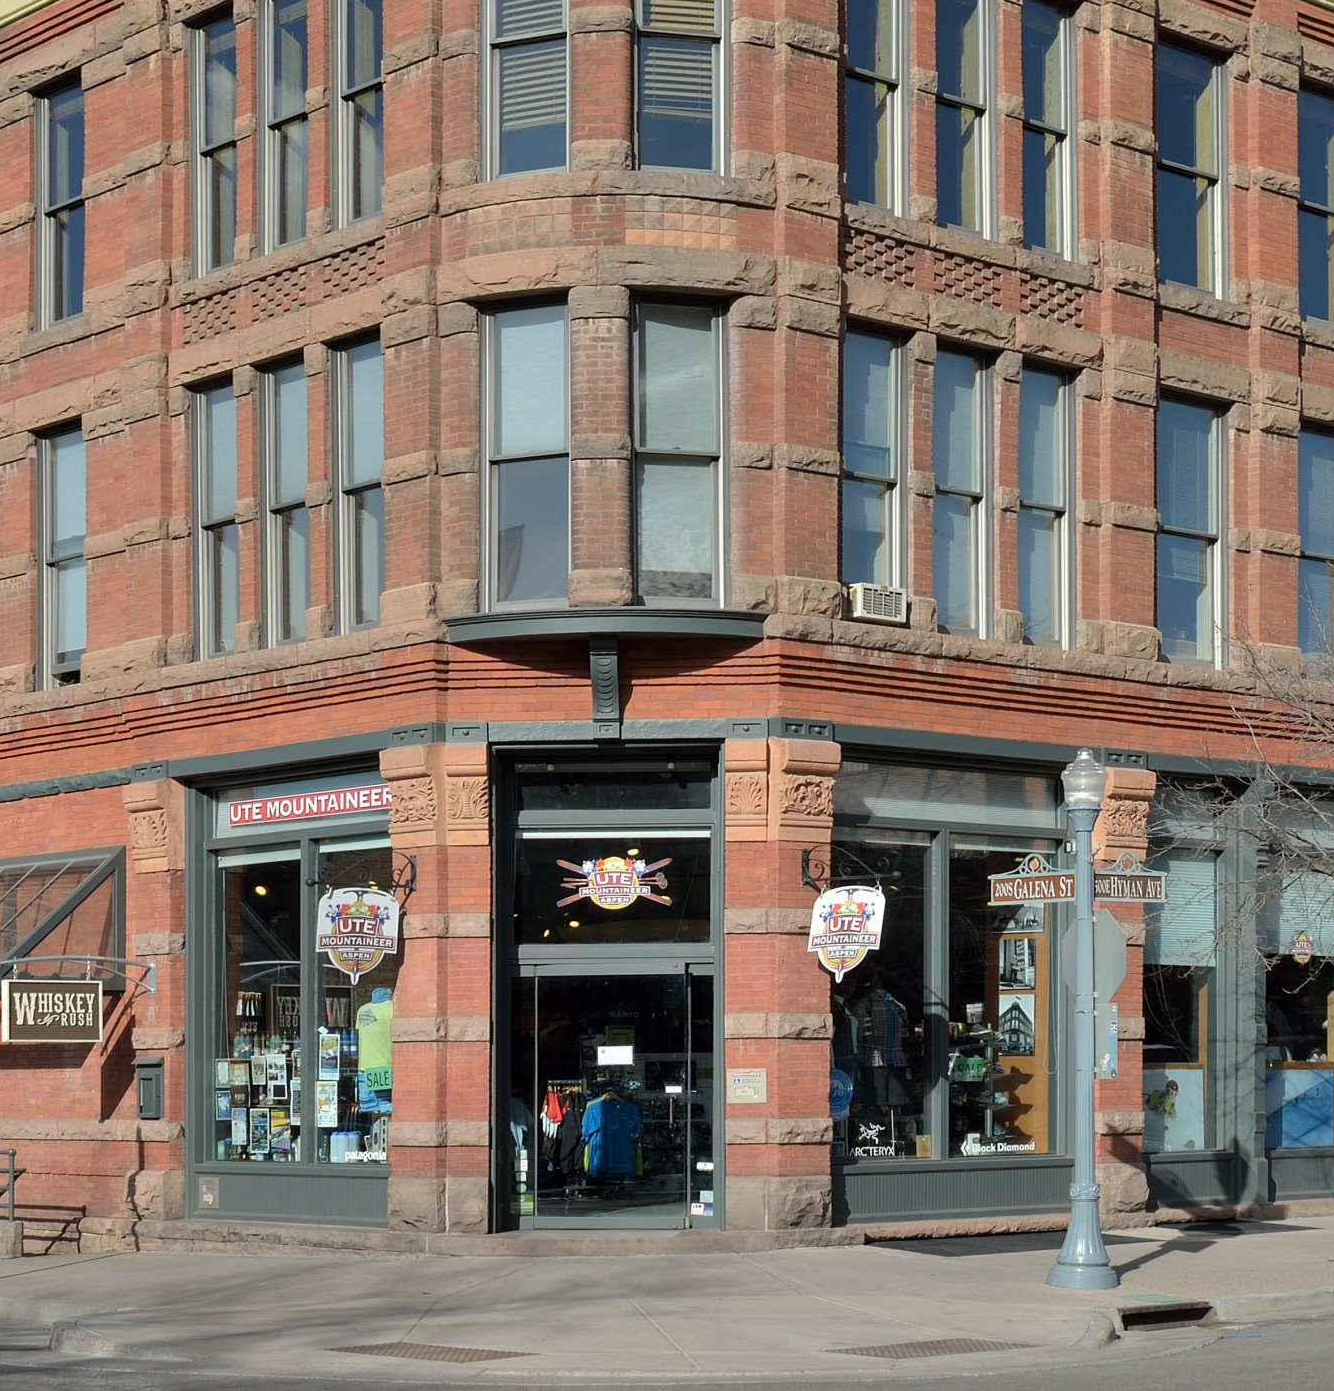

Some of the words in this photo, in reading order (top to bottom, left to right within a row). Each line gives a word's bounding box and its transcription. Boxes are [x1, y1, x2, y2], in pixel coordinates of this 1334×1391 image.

[230, 802, 263, 822] UTE
[267, 787, 393, 819] MOUNTAINEER
[595, 872, 633, 885] UTE
[581, 887, 648, 895] MOUNTAINEER
[1013, 878, 1055, 900] GALENA
[1059, 876, 1073, 898] ST
[1110, 876, 1143, 899] HYMAN
[1146, 878, 1161, 898] AVE
[339, 918, 376, 934] UTE
[829, 916, 862, 932] UTE
[321, 937, 393, 947] MOUNTAINEER
[812, 934, 876, 946] MOUNTAINEER
[12, 992, 95, 1026] WHISKEY
[60, 1013, 93, 1027] RUSH
[957, 1063, 983, 1078] SALE
[366, 1071, 390, 1089] SALE
[971, 1142, 996, 1153] Black
[997, 1141, 1035, 1152] Diamond
[344, 1149, 387, 1163] patagonia
